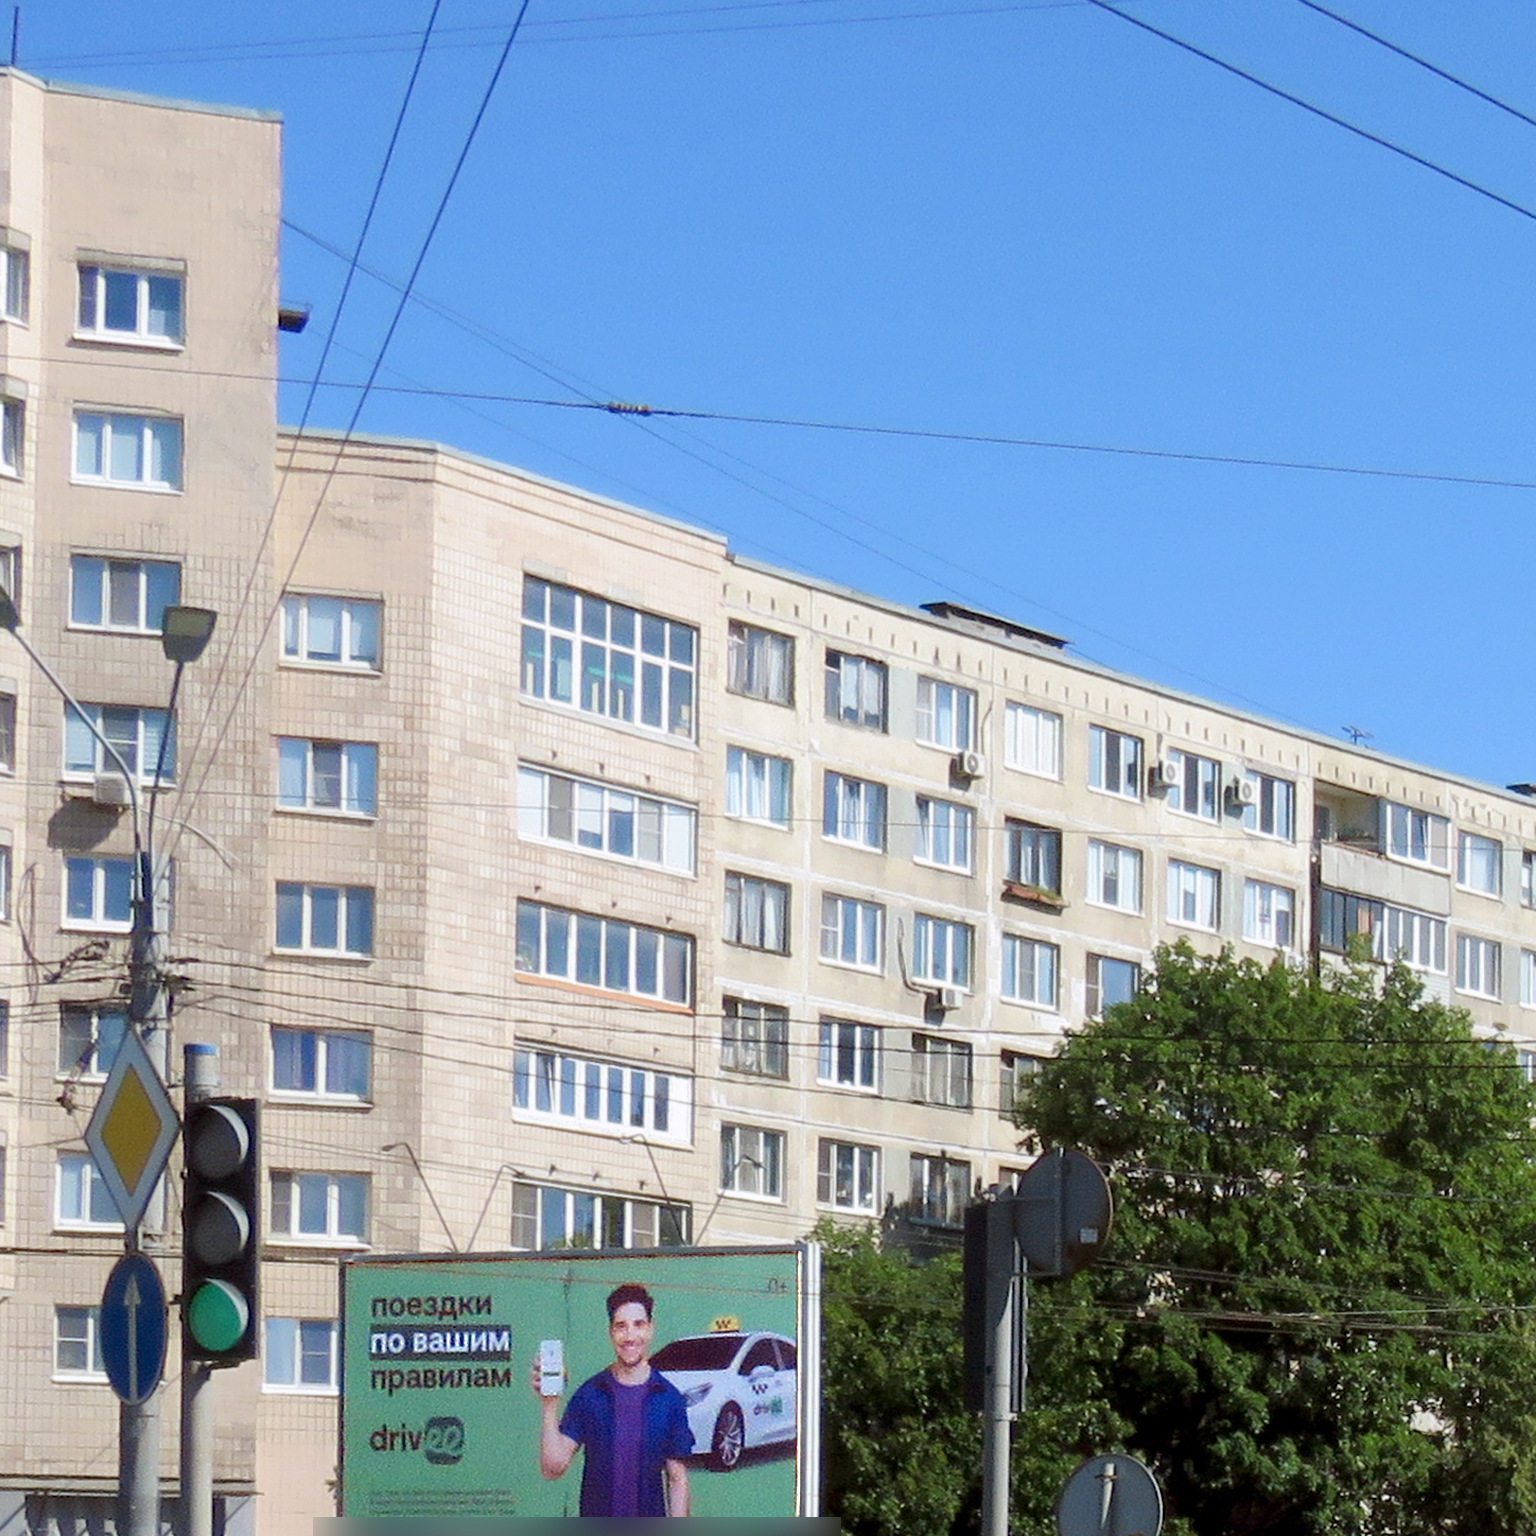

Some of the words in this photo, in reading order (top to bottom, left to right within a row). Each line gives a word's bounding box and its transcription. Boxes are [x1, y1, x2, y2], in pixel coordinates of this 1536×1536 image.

[370, 1295, 492, 1321] поездки
[370, 1332, 406, 1354] по
[412, 1330, 511, 1353] вашим
[370, 1367, 512, 1397] правилам
